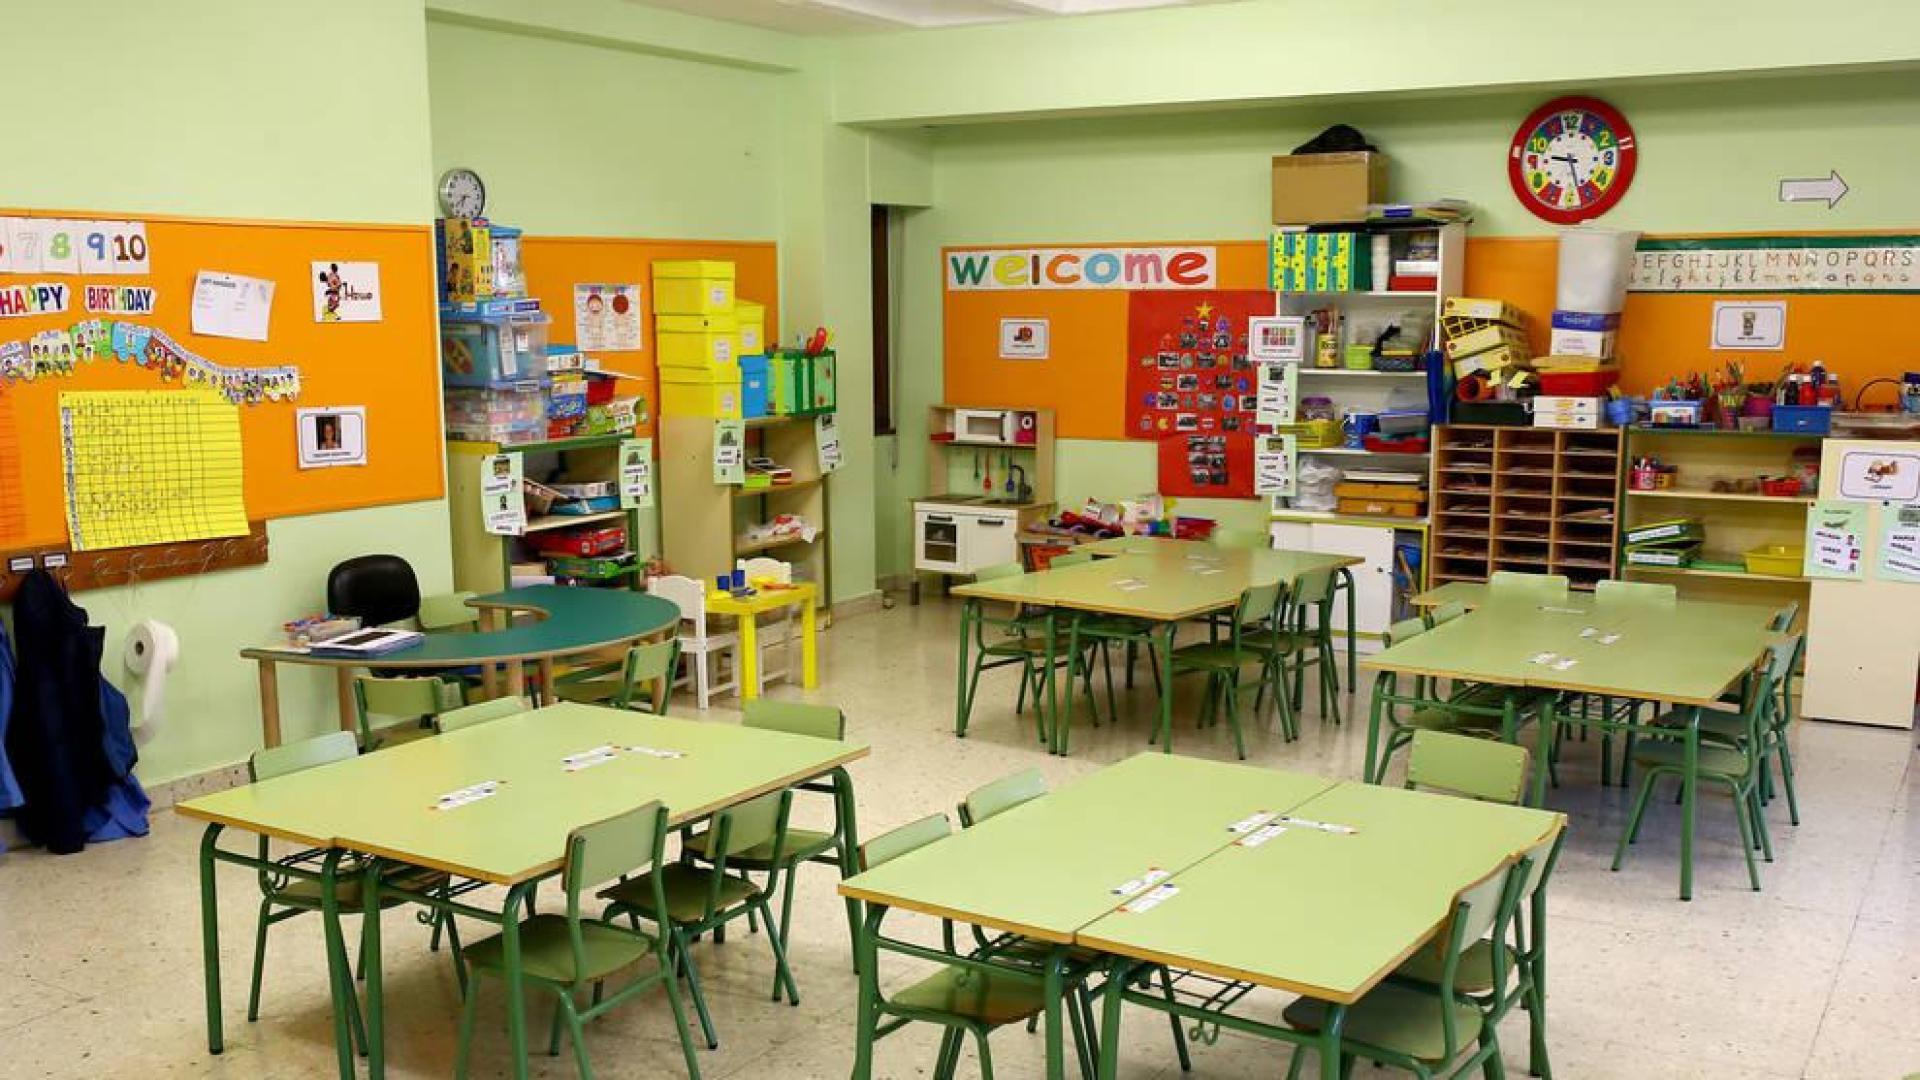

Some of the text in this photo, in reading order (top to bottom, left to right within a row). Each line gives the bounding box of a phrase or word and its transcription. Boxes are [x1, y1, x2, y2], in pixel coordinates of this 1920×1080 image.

[1563, 115, 1579, 129] 12
[1531, 137, 1549, 153] 10
[1600, 131, 1610, 146] 2
[1603, 150, 1615, 166] 3
[50, 232, 70, 260] 8
[86, 232, 105, 260] 9
[113, 233, 146, 261] 10
[951, 251, 1209, 285] welcome
[0, 286, 151, 315] HAPPY BIRTHDAY
